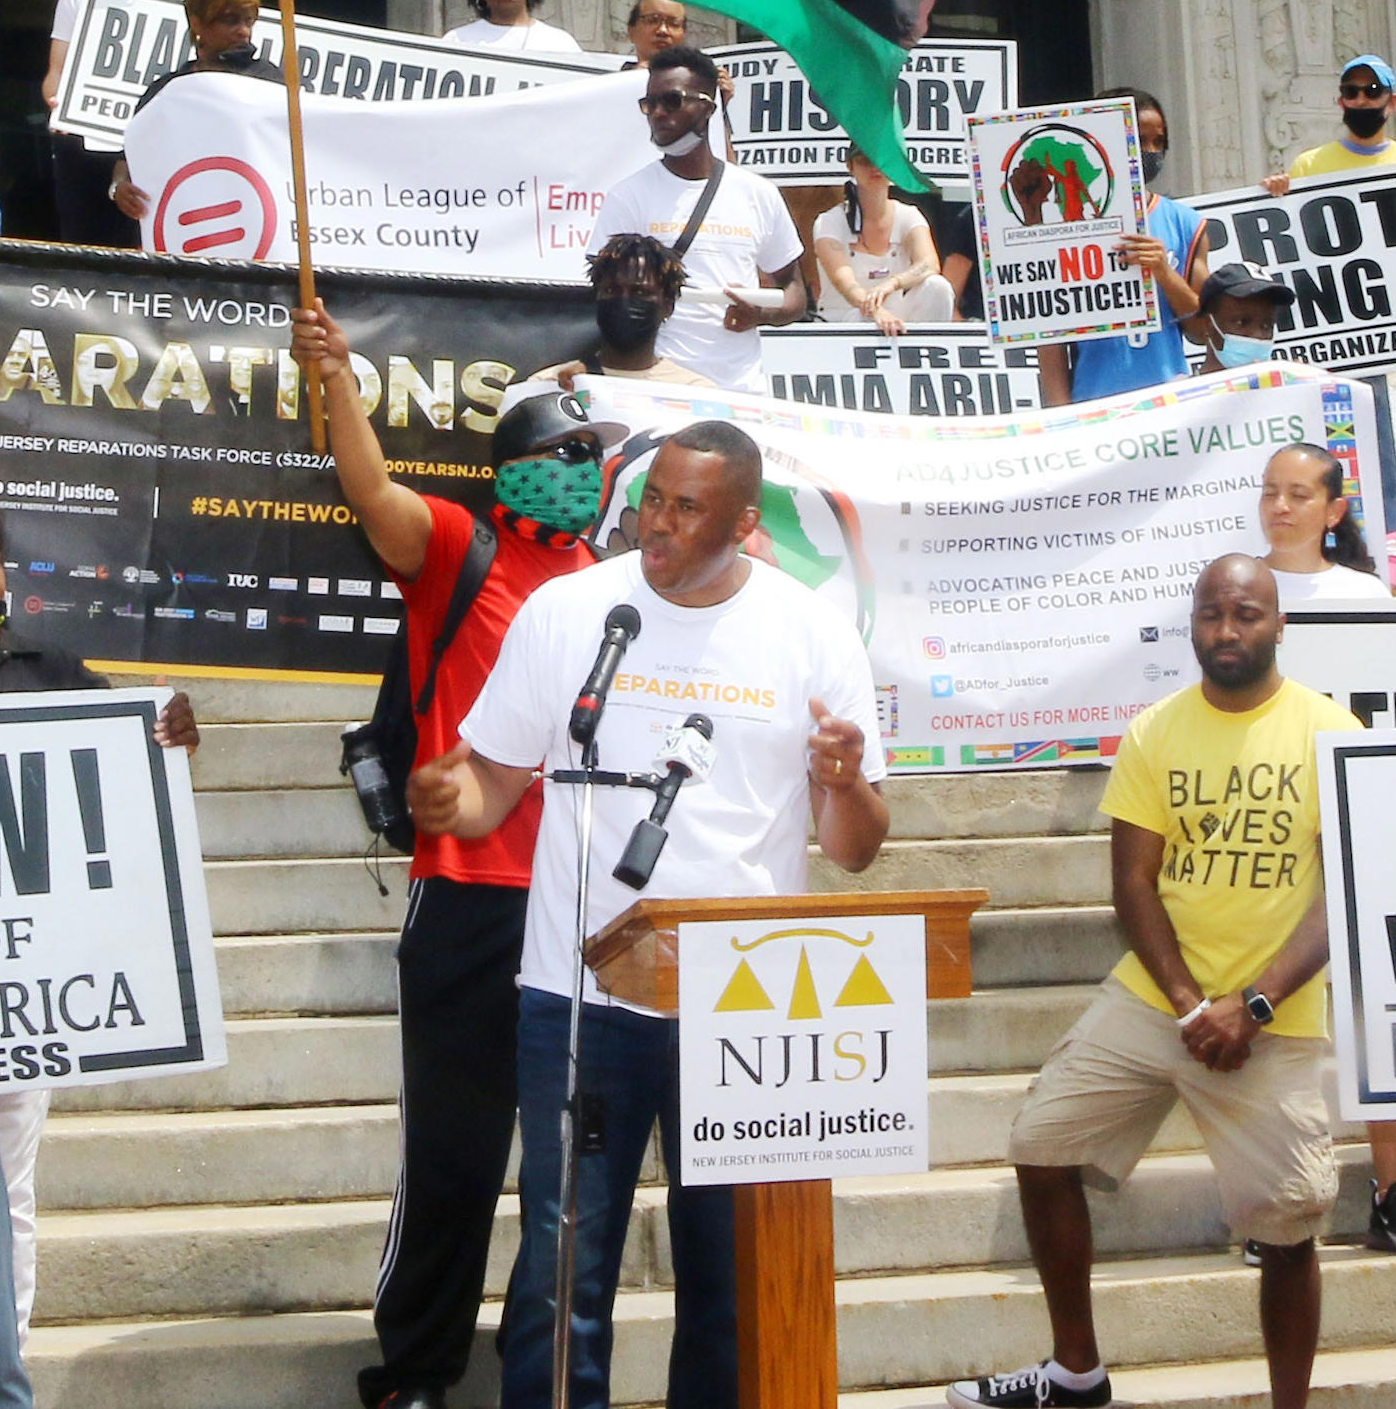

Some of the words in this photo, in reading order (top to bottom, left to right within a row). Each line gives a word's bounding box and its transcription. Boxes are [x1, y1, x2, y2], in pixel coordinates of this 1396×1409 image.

[384, 183, 487, 213] League
[497, 180, 527, 207] of
[376, 223, 480, 253] County
[1007, 228, 1038, 241] AFRICAN
[1038, 224, 1074, 239] DIASPORA
[1075, 222, 1090, 234] FOR
[1091, 220, 1120, 232] JUSTICE
[997, 263, 1023, 286] WE
[1027, 257, 1057, 282] SAY
[1058, 244, 1105, 283] NO
[29, 284, 96, 311] SAY
[105, 290, 173, 319] THE
[182, 296, 292, 329] WORD
[999, 279, 1142, 322] INJUSTICE!!
[58, 438, 167, 458] REPARATIONS
[170, 445, 212, 462] TASK
[216, 448, 272, 467] FORCE
[1095, 428, 1179, 463] CORE
[1185, 414, 1307, 455] VALUES
[7, 480, 56, 498] social
[58, 481, 120, 503] justice.
[924, 499, 1005, 517] SEEKING
[1009, 494, 1082, 514] JUSTICE
[1086, 490, 1123, 508] FOR
[1127, 487, 1160, 504] THE
[921, 534, 1039, 555] SUPPORTING
[1045, 530, 1117, 550] VICTIMS
[1121, 527, 1146, 544] OF
[1151, 514, 1247, 541] INJUSTICE
[927, 573, 1048, 594] ADVOCATING
[1052, 569, 1116, 588] PEACE
[1121, 565, 1160, 584] AND
[929, 598, 1002, 615] PEOPLE
[1007, 595, 1032, 611] OF
[1037, 592, 1104, 610] COLOR
[1108, 587, 1147, 605] AND
[611, 672, 776, 709] EPARATIONS
[954, 676, 1050, 692] @ADfor_Justice
[931, 713, 1006, 731] CONTACT
[1009, 711, 1030, 727] US
[1033, 708, 1064, 725] FOR
[1067, 706, 1110, 723] MORE
[1168, 763, 1303, 808] BLACK
[1163, 845, 1298, 890] MATTER
[714, 1029, 894, 1089] NJISJ
[693, 1116, 725, 1142] do
[733, 1111, 811, 1140] social
[818, 1107, 915, 1142] justice.
[692, 1156, 716, 1169] NEW
[719, 1154, 756, 1167] JERSEY
[758, 1151, 810, 1165] INSTITUTE
[813, 1149, 834, 1162] FOR
[836, 1148, 872, 1161] SOCIAL
[874, 1145, 915, 1158] JUSTICE
